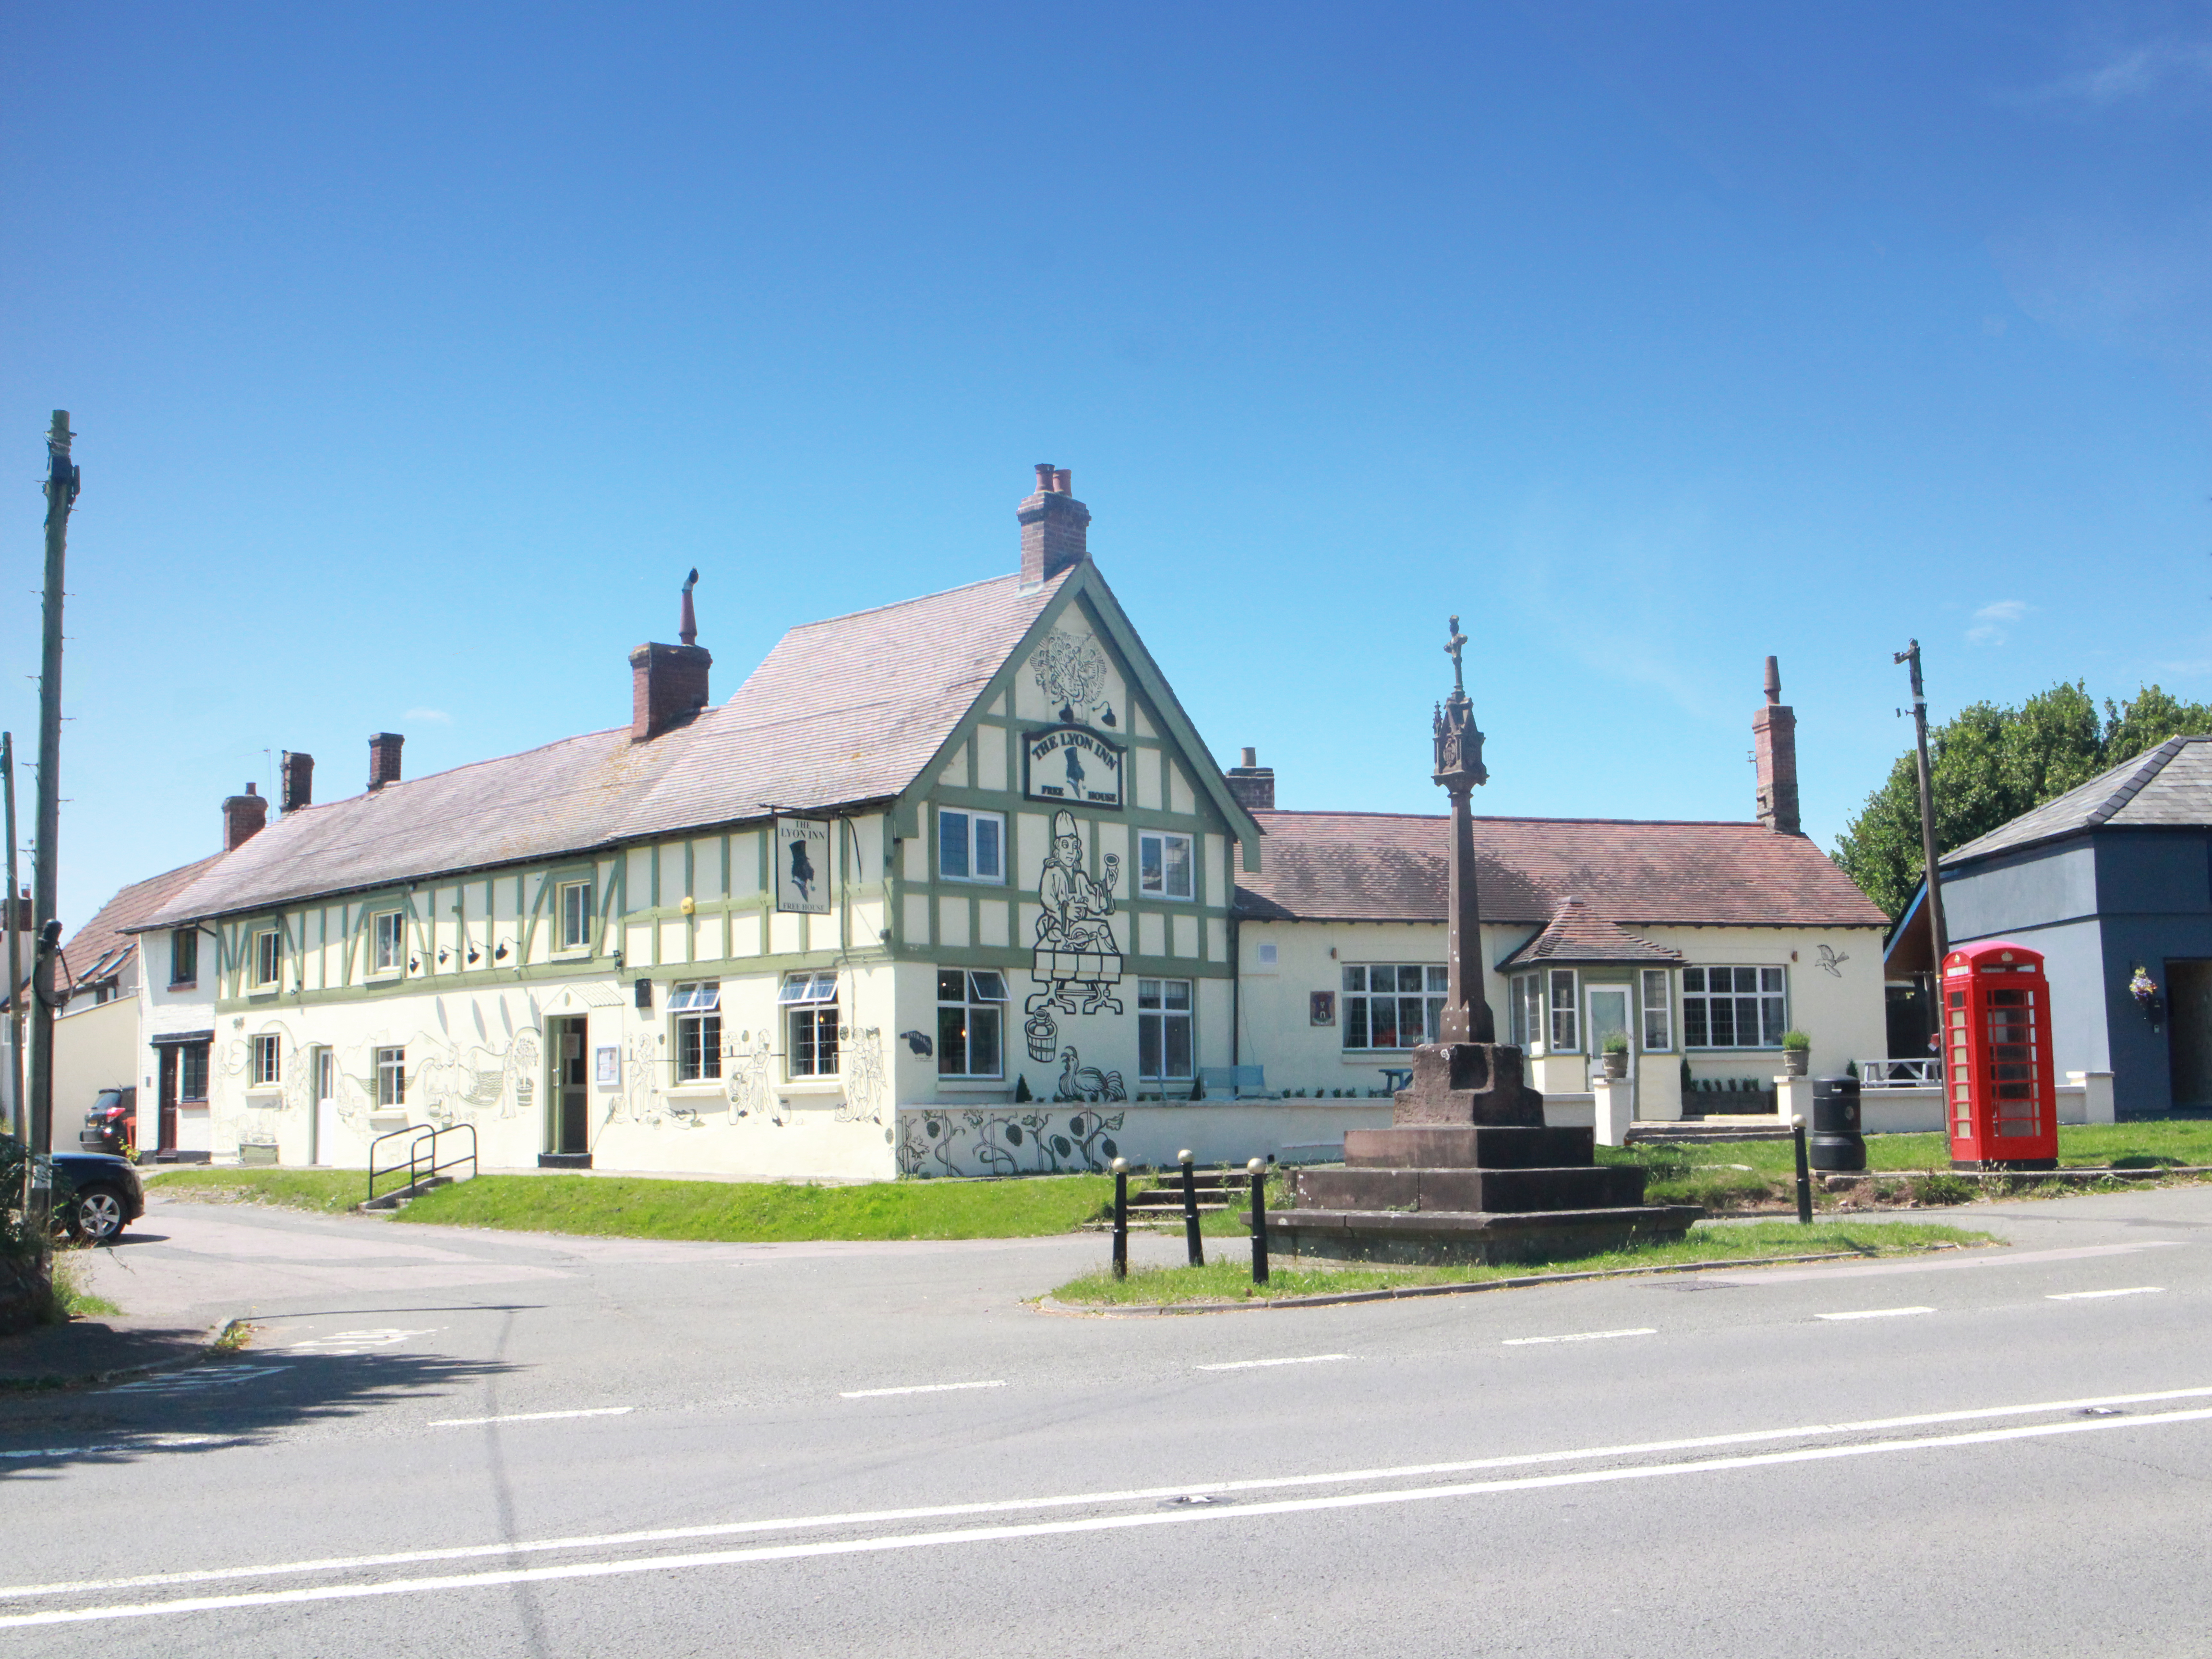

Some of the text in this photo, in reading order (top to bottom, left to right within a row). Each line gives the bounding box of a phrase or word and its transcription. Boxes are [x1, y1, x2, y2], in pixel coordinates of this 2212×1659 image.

[1032, 733, 1118, 770] THE LYON INN
[1042, 786, 1117, 802] FREE HOUSE
[795, 820, 811, 829] THE
[781, 828, 826, 840] LYON INN
